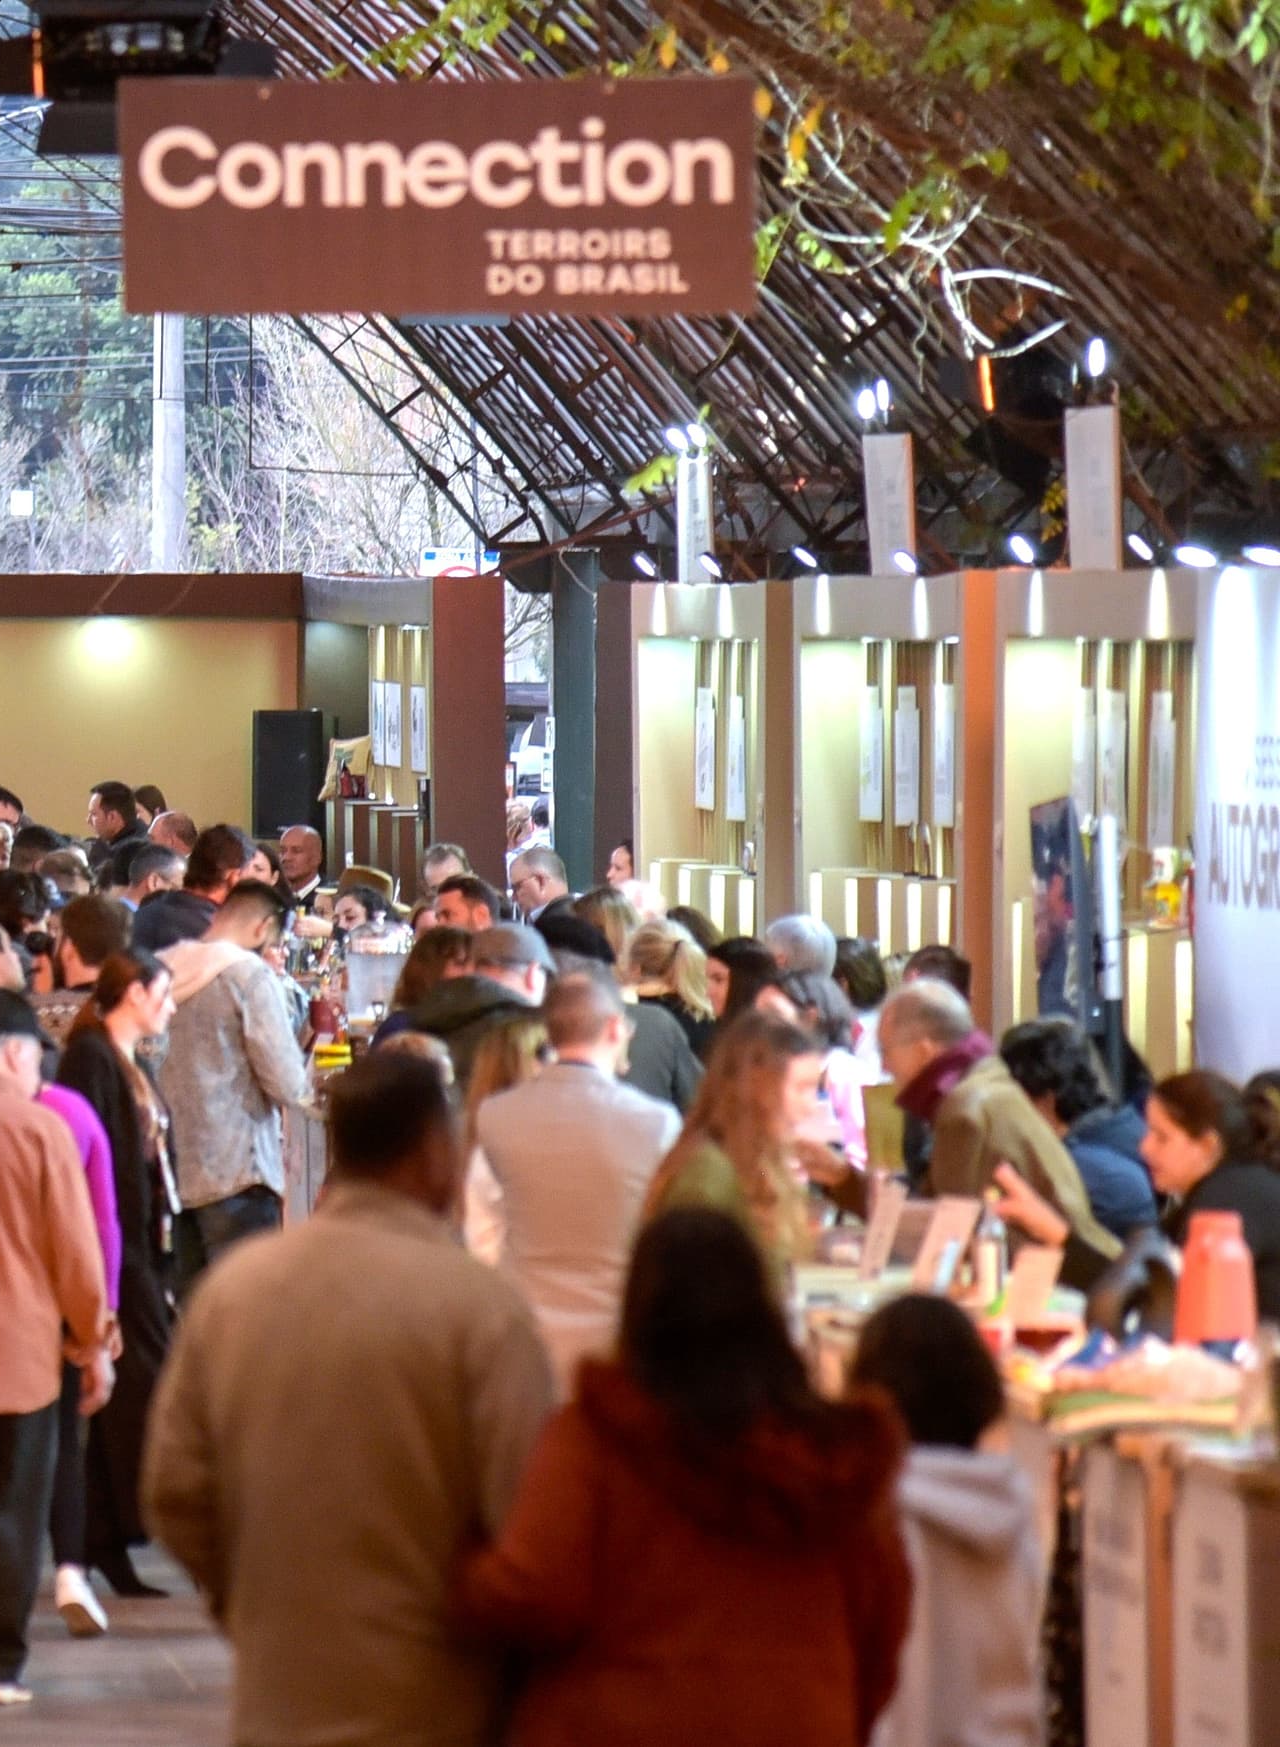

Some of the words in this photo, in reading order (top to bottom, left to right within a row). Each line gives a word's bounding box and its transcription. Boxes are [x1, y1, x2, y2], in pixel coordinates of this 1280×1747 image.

[139, 116, 736, 209] Connection
[485, 228, 671, 262] TERROIRS
[485, 263, 545, 296] DO
[555, 263, 690, 296] BRASIL
